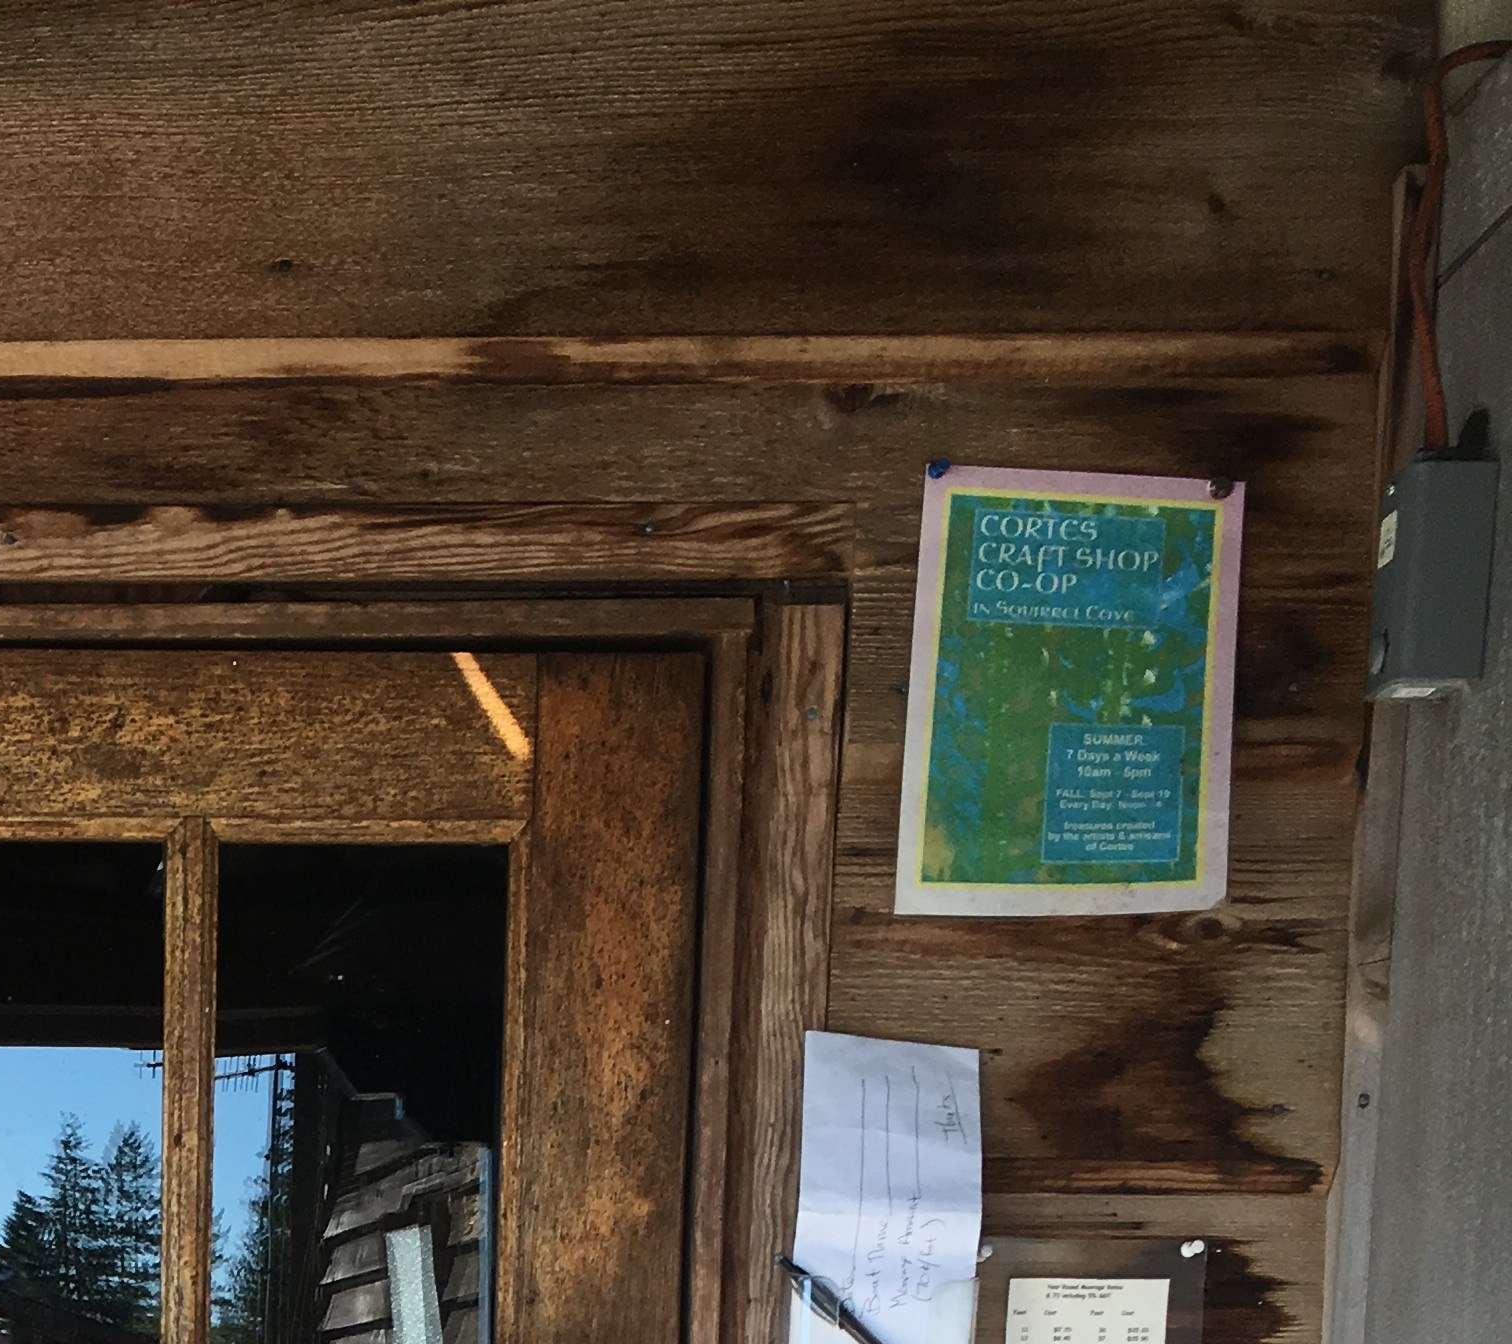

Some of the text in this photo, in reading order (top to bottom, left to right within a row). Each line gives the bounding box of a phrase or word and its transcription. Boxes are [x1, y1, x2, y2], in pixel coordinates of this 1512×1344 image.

[980, 515, 1098, 541] CORTES
[978, 542, 1160, 572] CRAFT SHOP
[976, 569, 1077, 594] CO-OP
[1066, 749, 1074, 760] 7
[1077, 749, 1110, 764] Days
[1124, 750, 1161, 762] Week
